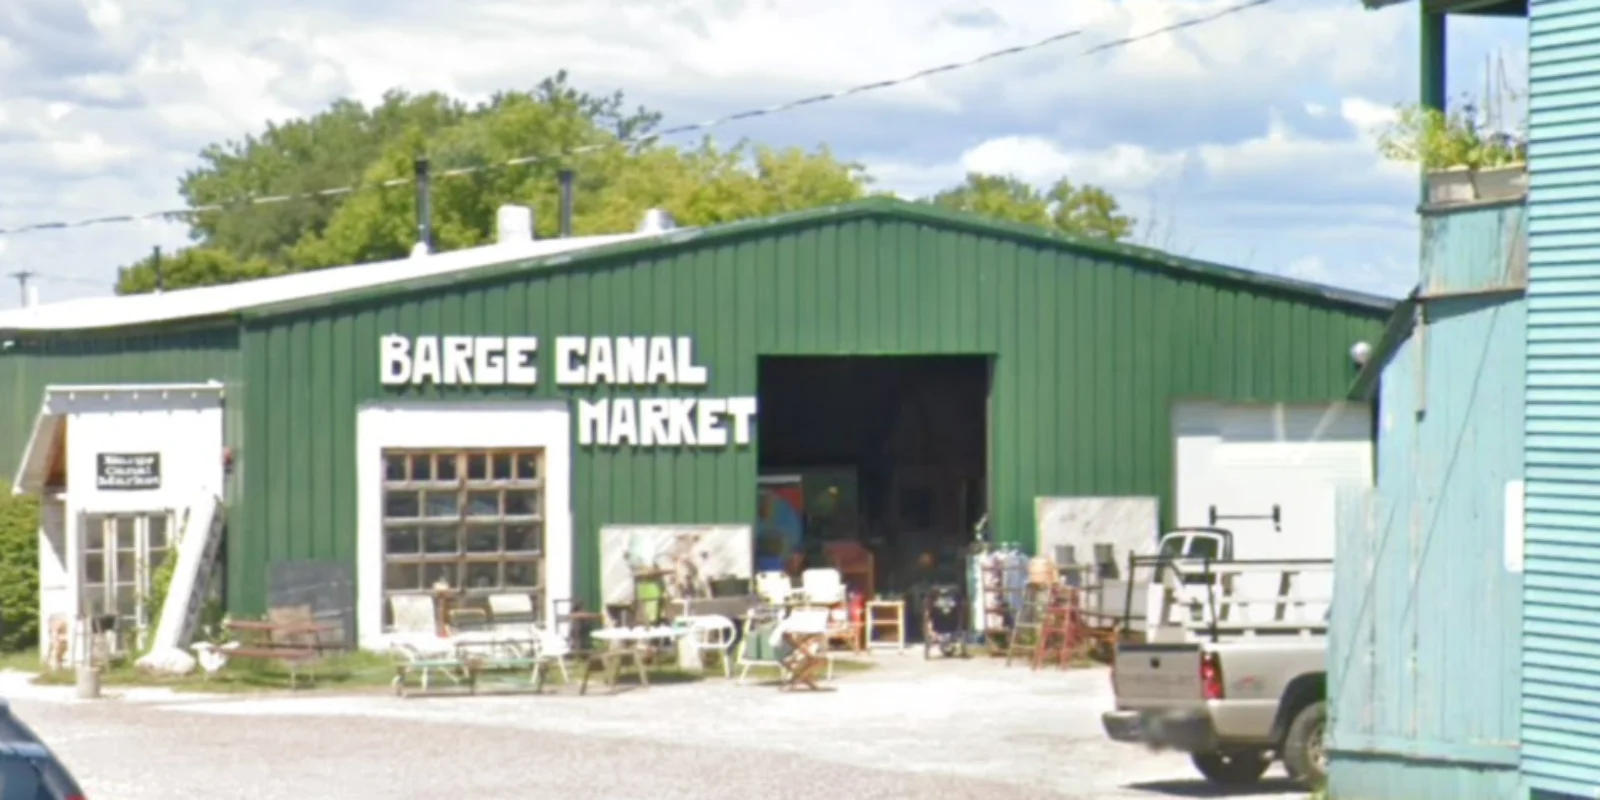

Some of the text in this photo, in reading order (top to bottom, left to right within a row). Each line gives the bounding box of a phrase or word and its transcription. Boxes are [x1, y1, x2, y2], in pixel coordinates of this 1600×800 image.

[380, 334, 707, 385] BARGE CANAL
[578, 397, 757, 446] MARKET
[104, 466, 153, 476] Canal
